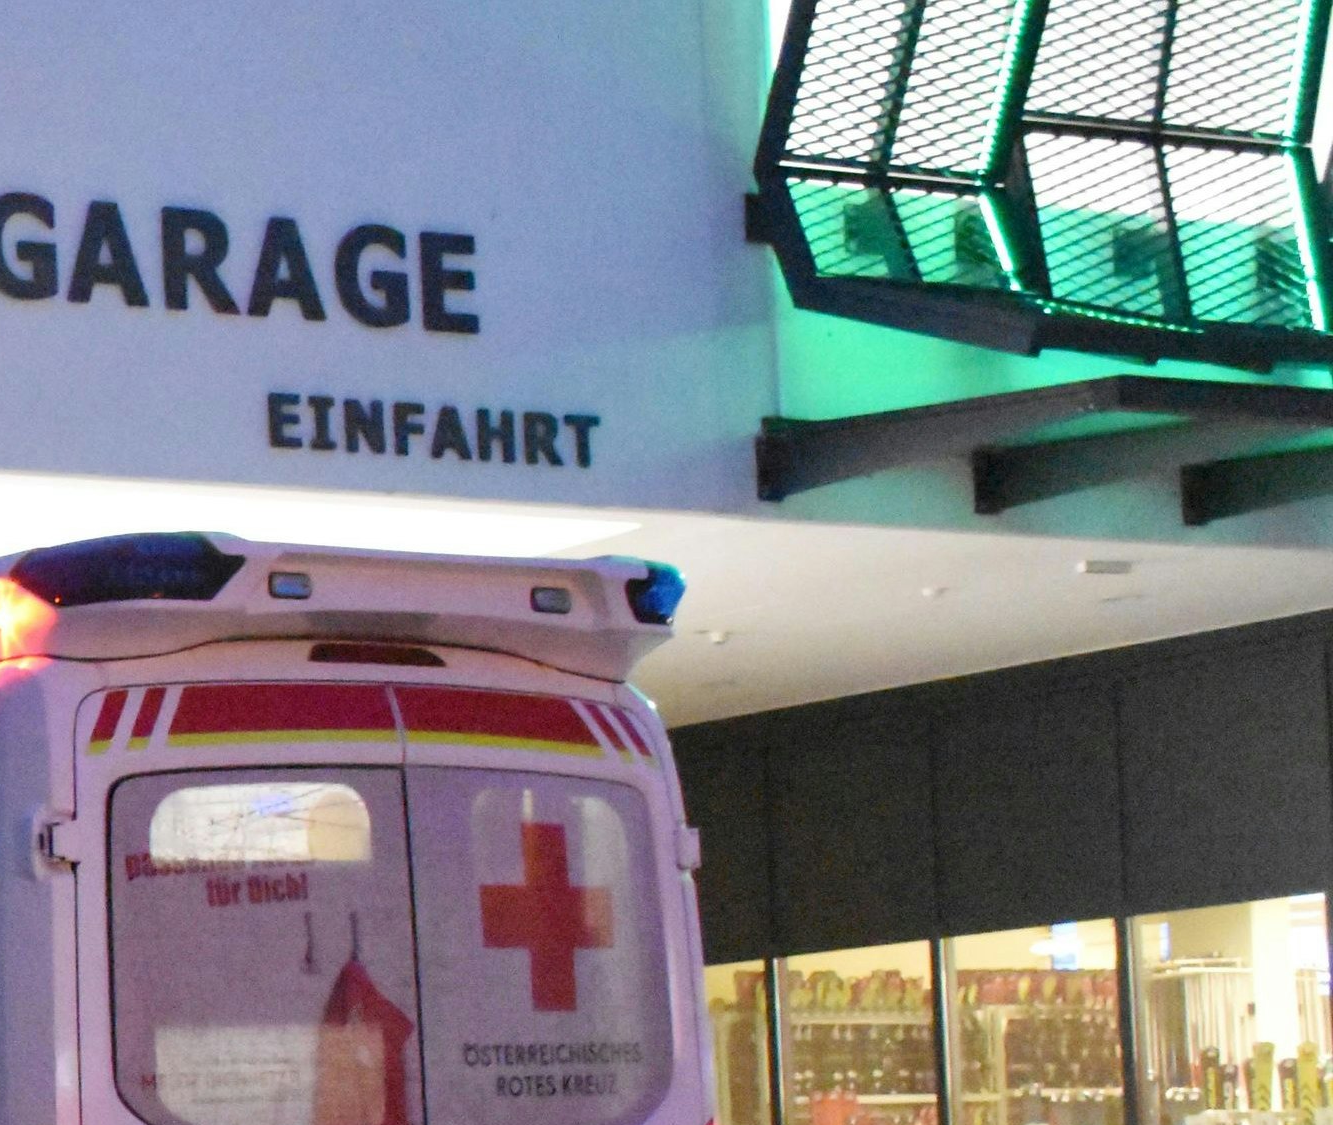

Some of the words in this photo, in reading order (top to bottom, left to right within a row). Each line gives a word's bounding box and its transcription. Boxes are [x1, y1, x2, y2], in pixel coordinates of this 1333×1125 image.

[266, 391, 602, 470] EINFAHRT
[462, 1042, 643, 1067] ÖSTERREICHISCHES
[496, 1074, 556, 1097] ROTES
[562, 1073, 618, 1096] KREUZ
